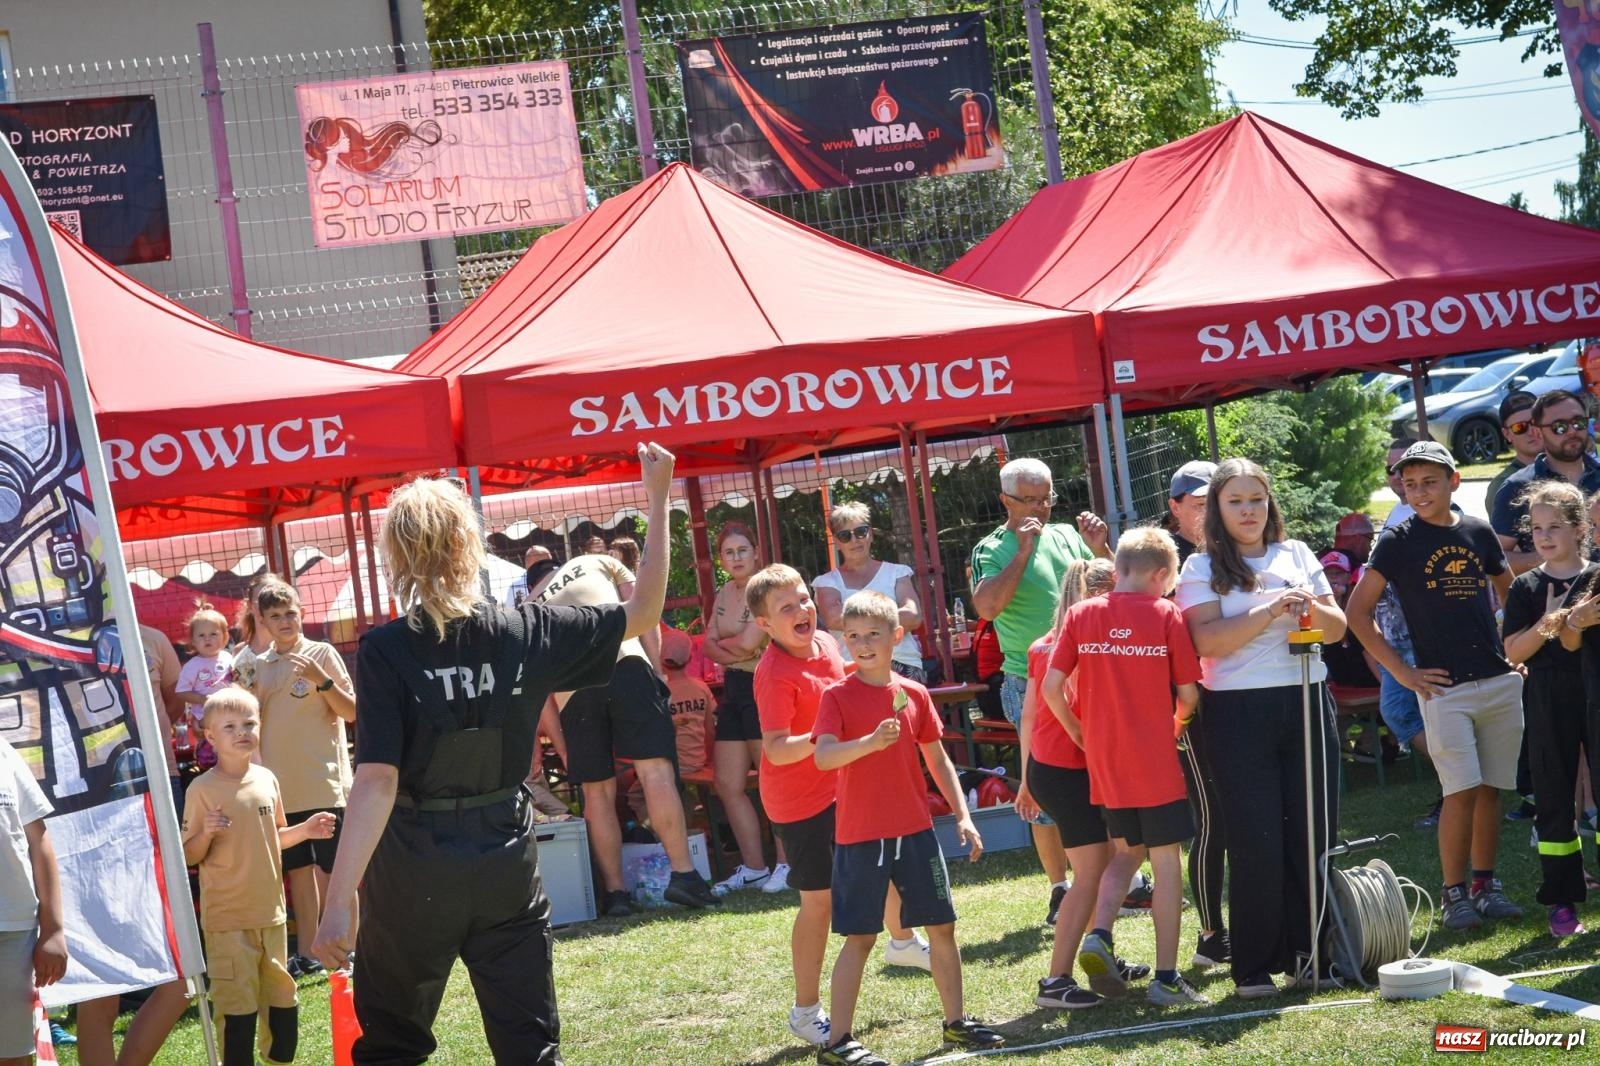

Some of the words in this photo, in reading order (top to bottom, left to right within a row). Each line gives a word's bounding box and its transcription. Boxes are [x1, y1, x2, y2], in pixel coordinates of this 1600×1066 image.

[767, 36, 812, 49] Legalizacja
[819, 29, 855, 44] sprzedaż
[857, 28, 883, 41] gaśnic
[897, 24, 928, 38] Operaty
[760, 51, 793, 66] Czujniki
[794, 51, 817, 64] dymu
[824, 49, 848, 60] czadu
[861, 43, 900, 56] Szkolenia
[902, 37, 969, 53] przeciwpożarowe
[786, 68, 826, 81] Instrukcje
[827, 61, 890, 77] bezpieczeństwa
[891, 57, 939, 70] pożarowego
[355, 89, 360, 100] 1
[363, 87, 391, 101] Maja
[394, 85, 410, 97] 17,
[413, 81, 450, 94] 47-480
[452, 75, 514, 90] Pietrowice
[517, 71, 561, 84] Wielkie
[401, 103, 429, 120] tel.
[433, 95, 472, 117] 533
[479, 92, 519, 112] 354
[525, 88, 563, 107] 333
[32, 124, 133, 144] HORYZONT
[18, 153, 92, 166] OTOGRAFIA
[48, 164, 127, 178] POWIETRZA
[320, 175, 462, 210] SOLARIUM
[324, 210, 427, 241] STUDIO
[432, 199, 532, 230] FRYZUR
[1197, 280, 1600, 364] SAMBOROWICE
[568, 355, 1014, 437] SAMBOROWICE
[1443, 559, 1468, 574] 4F
[1109, 628, 1132, 639] OSP
[1078, 641, 1168, 657] KRZYŻANOWICE
